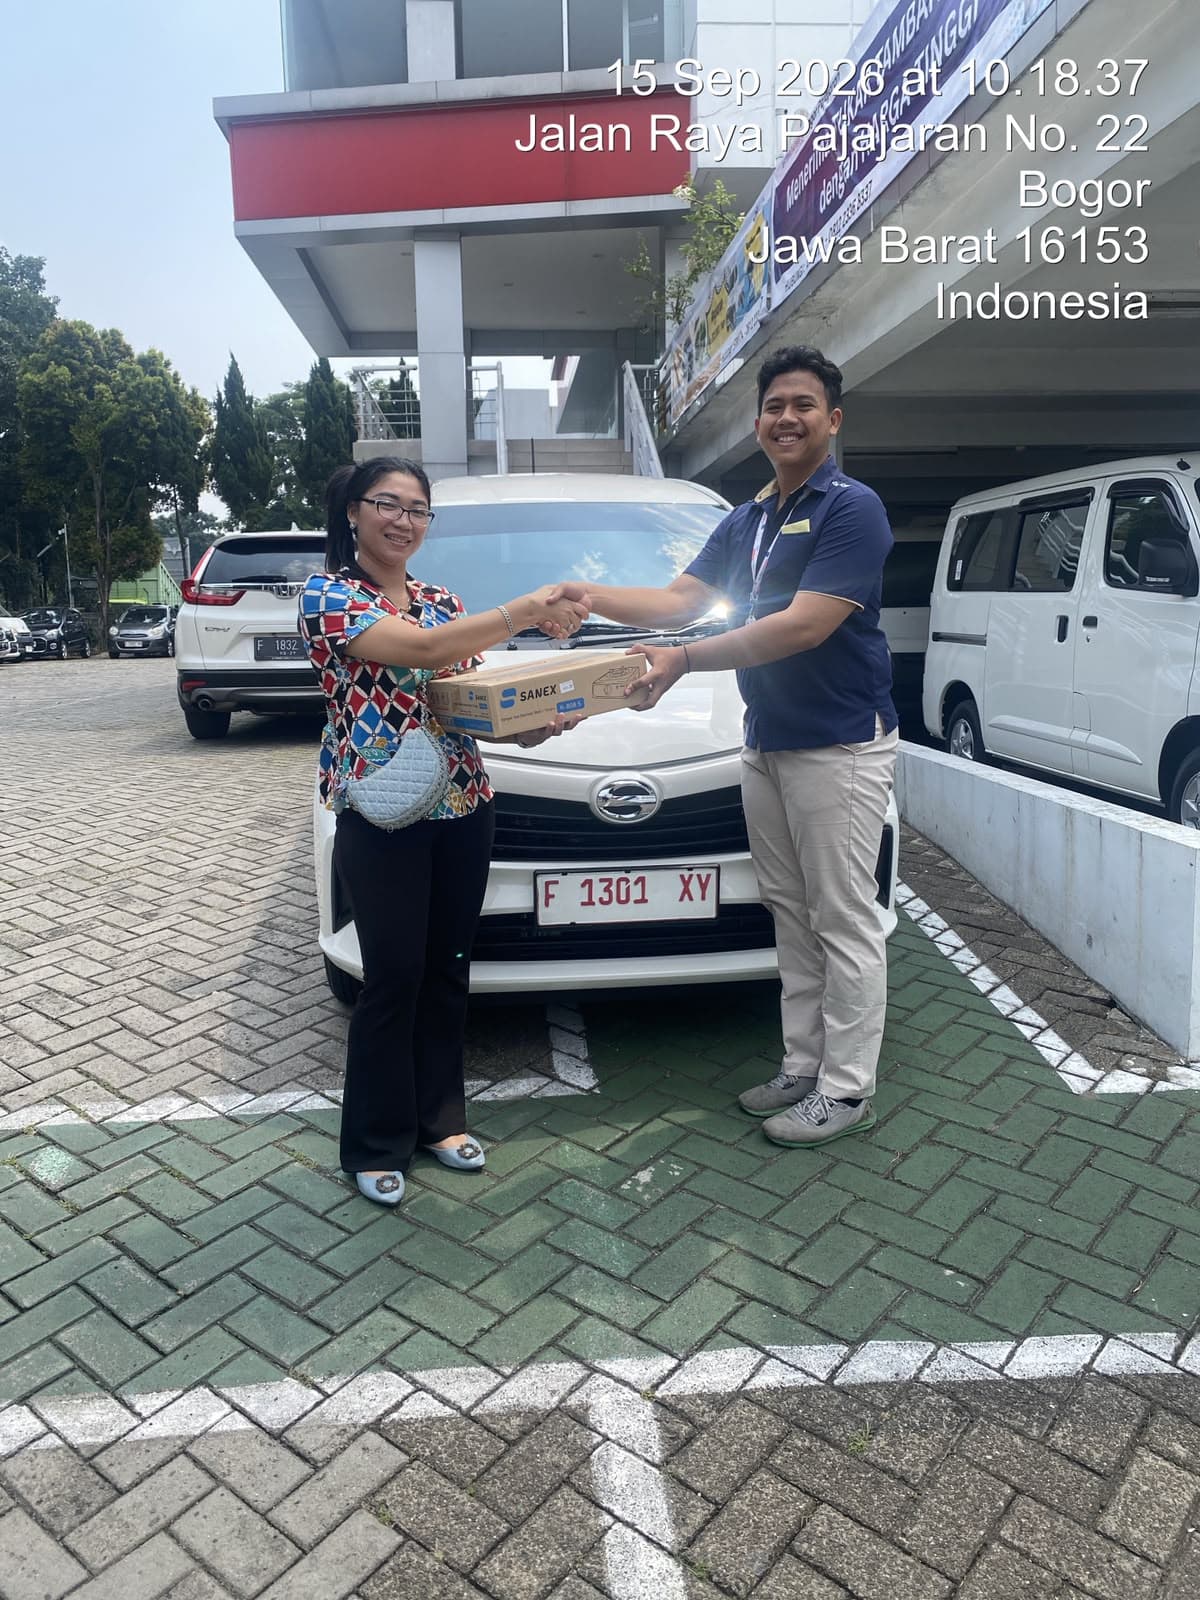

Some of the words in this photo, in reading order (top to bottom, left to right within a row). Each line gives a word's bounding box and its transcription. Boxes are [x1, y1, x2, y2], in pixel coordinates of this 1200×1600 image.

[872, 0, 934, 88] TAMBA
[819, 147, 859, 214] dengan
[913, 0, 979, 92] TINGGI
[257, 640, 264, 651] F
[275, 640, 299, 651] 1832
[520, 684, 557, 702] SANEX
[544, 880, 560, 908] F
[580, 876, 649, 906] 1301
[678, 873, 712, 902] XY
